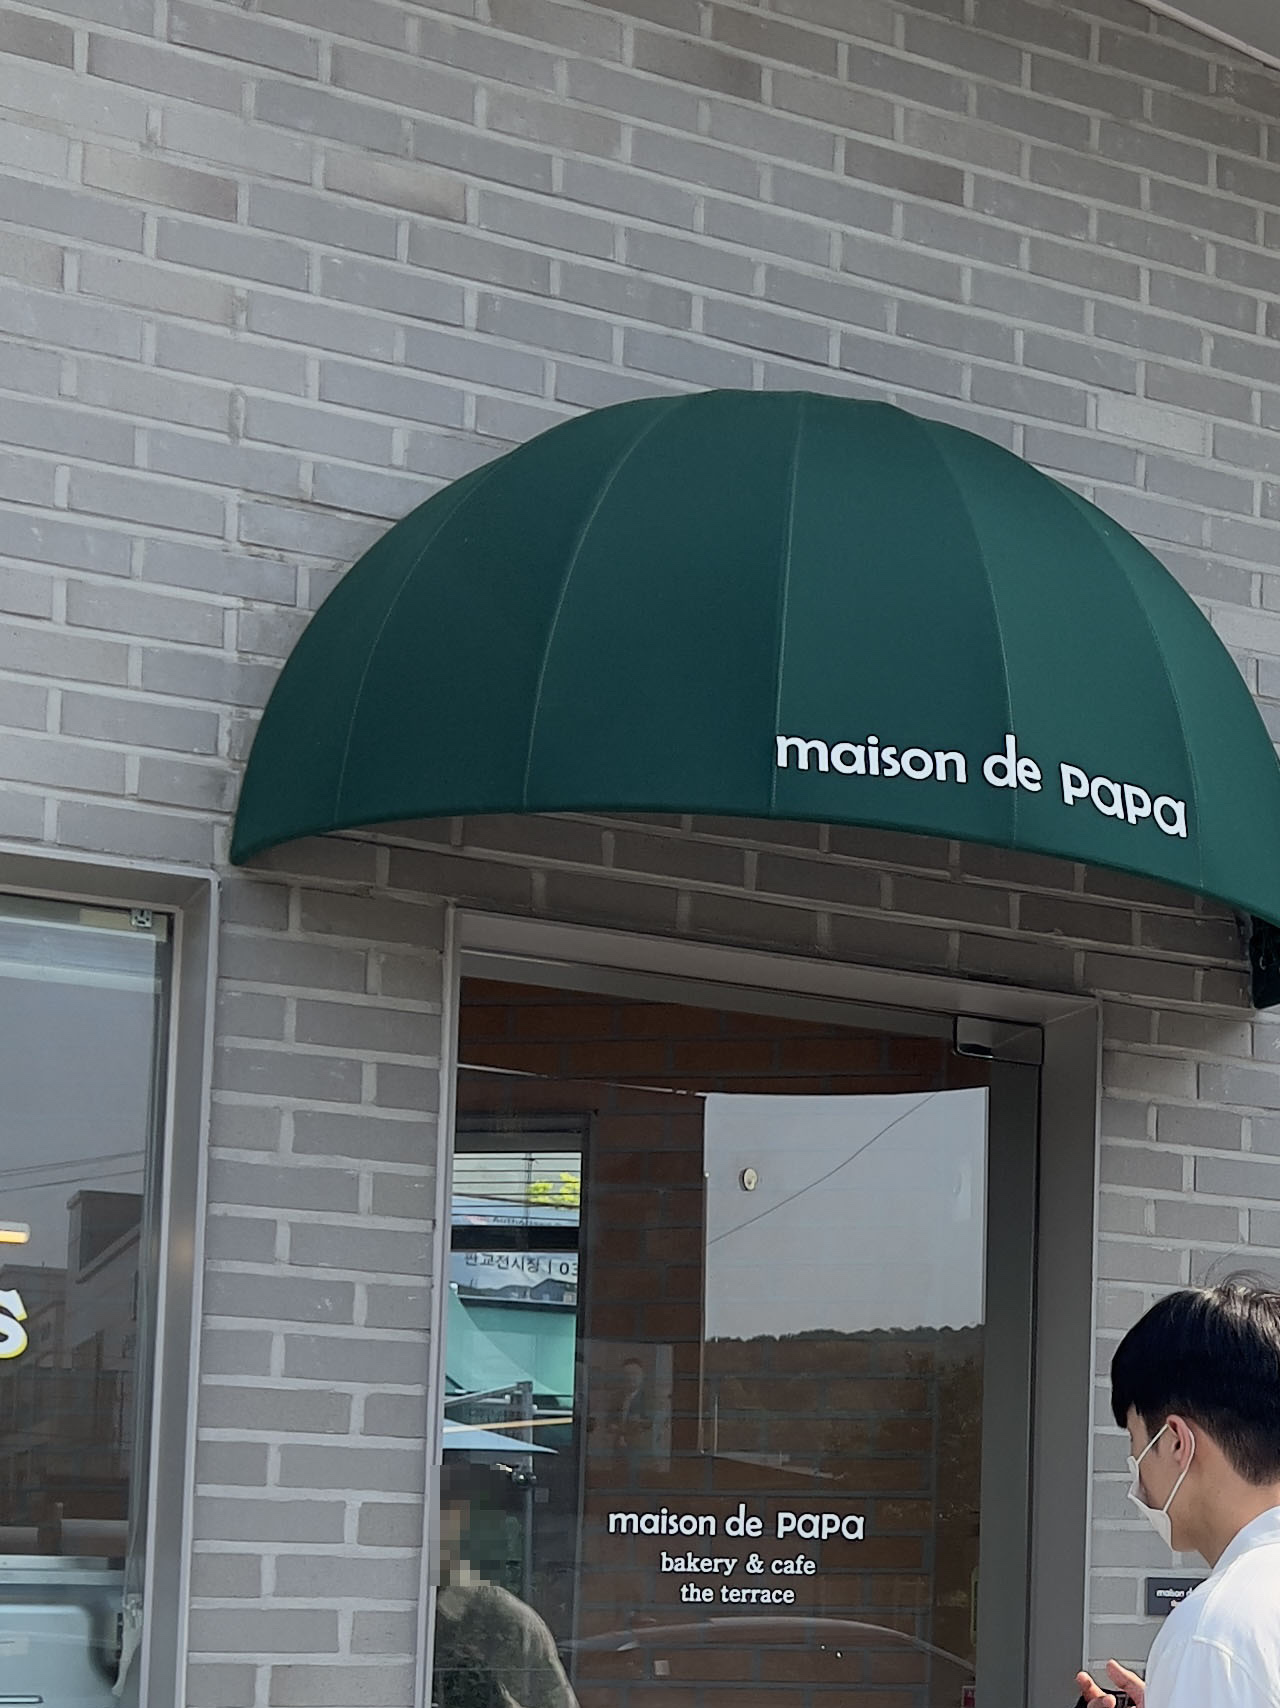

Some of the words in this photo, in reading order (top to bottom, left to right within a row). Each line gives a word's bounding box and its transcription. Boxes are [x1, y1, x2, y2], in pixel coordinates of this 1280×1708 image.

[776, 735, 967, 784] maison
[983, 734, 1042, 792] de
[608, 1508, 716, 1536] maison
[725, 1504, 763, 1537] de
[660, 1552, 738, 1576] bakery
[745, 1553, 764, 1574] &
[771, 1555, 816, 1575] cafe
[680, 1583, 714, 1602] the
[721, 1584, 795, 1603] terrace
